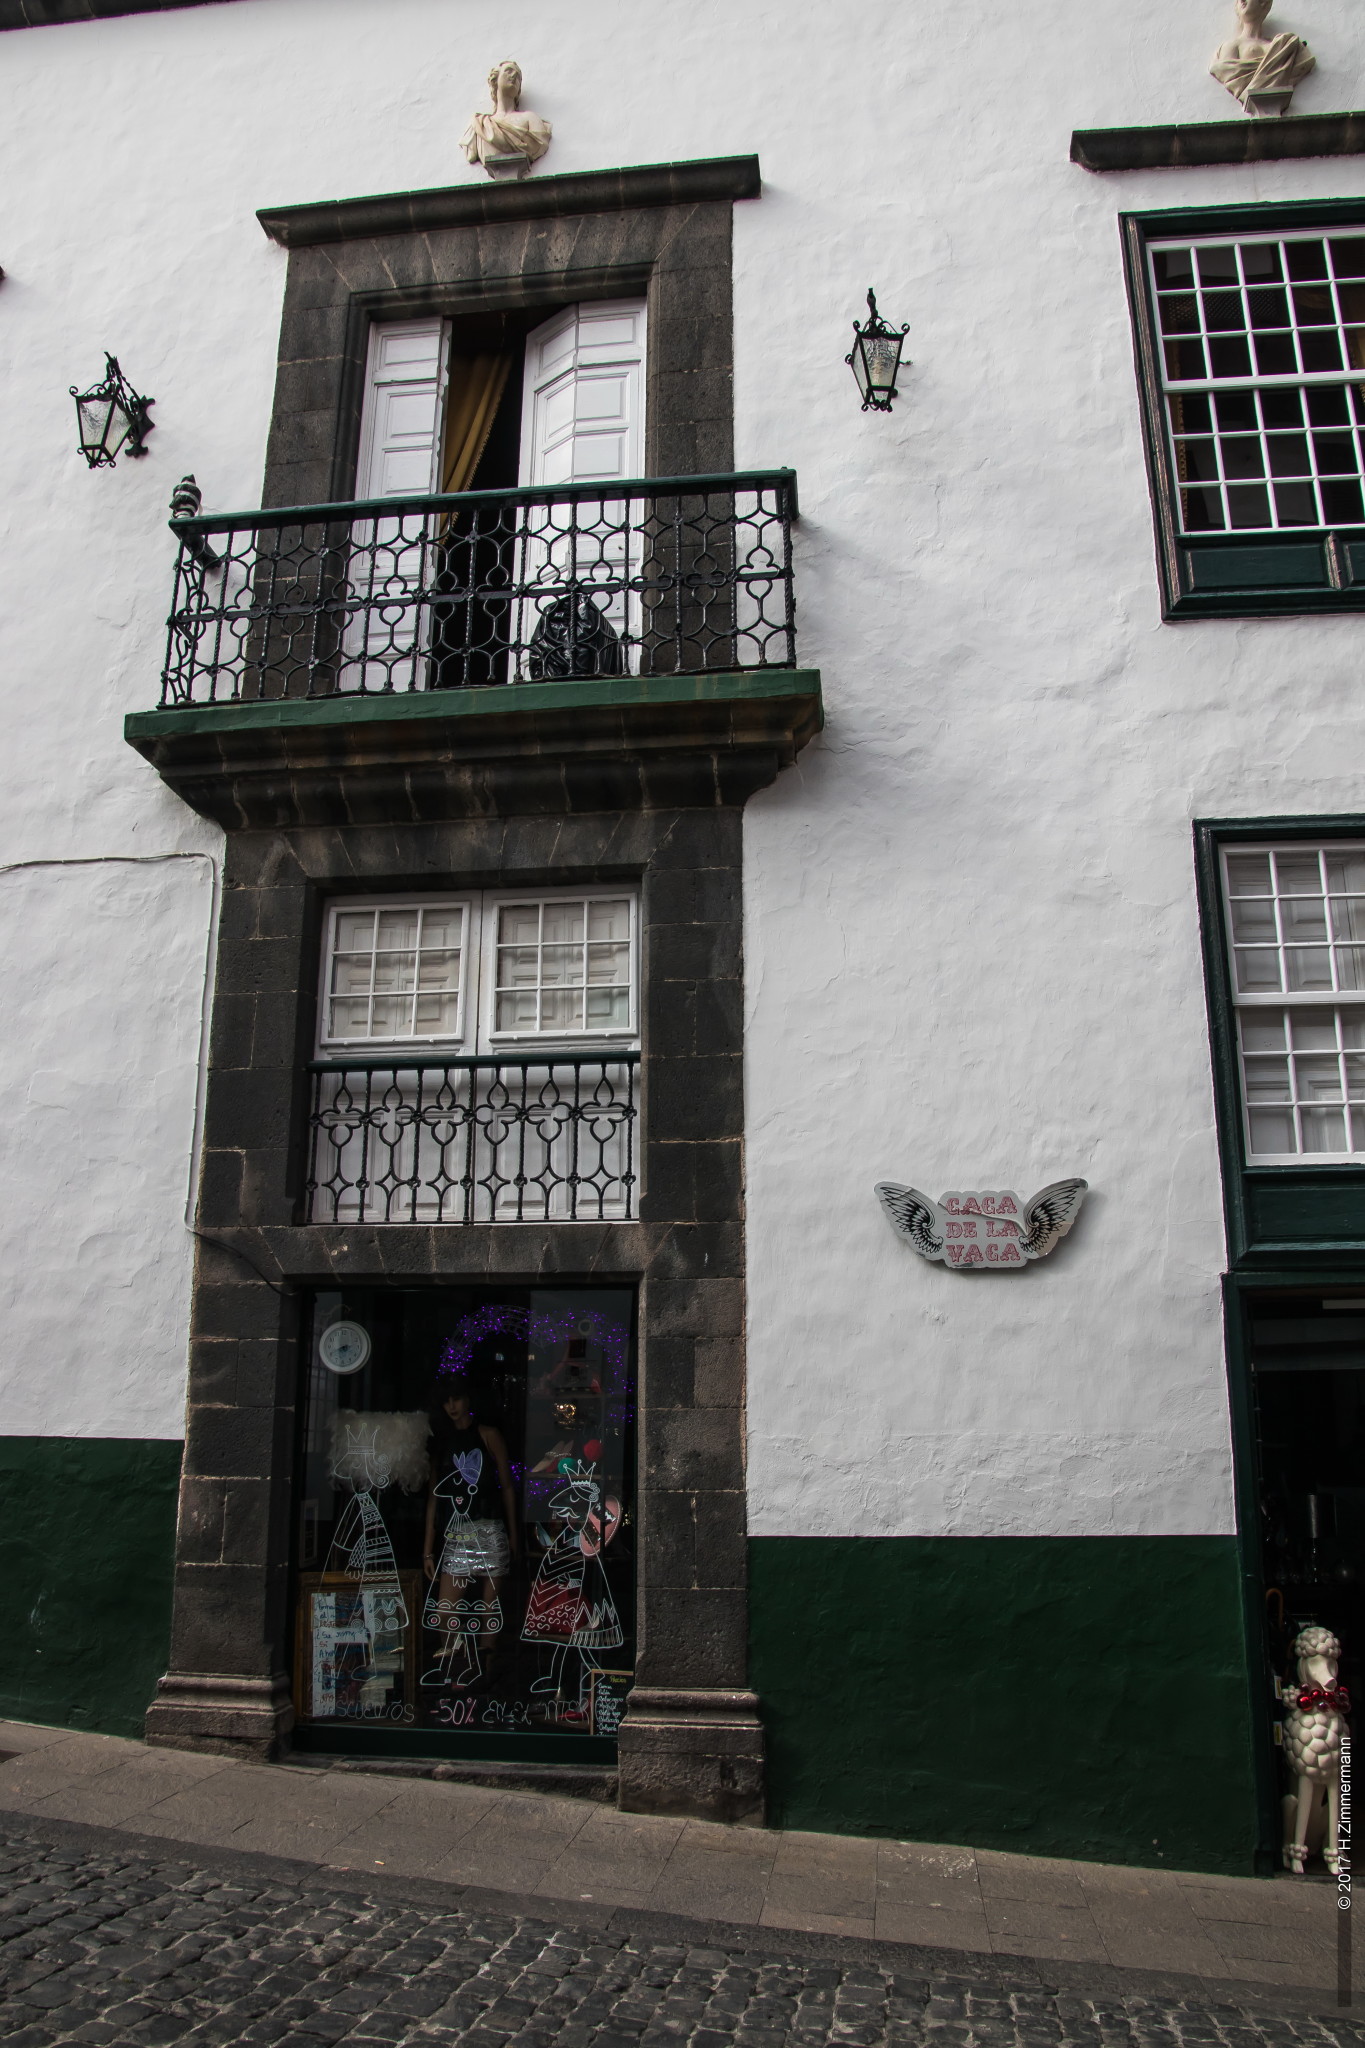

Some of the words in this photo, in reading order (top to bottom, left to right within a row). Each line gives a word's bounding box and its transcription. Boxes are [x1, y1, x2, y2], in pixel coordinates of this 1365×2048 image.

[946, 1196, 1018, 1215] CACA
[945, 1221, 977, 1238] DE
[986, 1220, 1019, 1238] LA
[945, 1243, 1021, 1262] VACA
